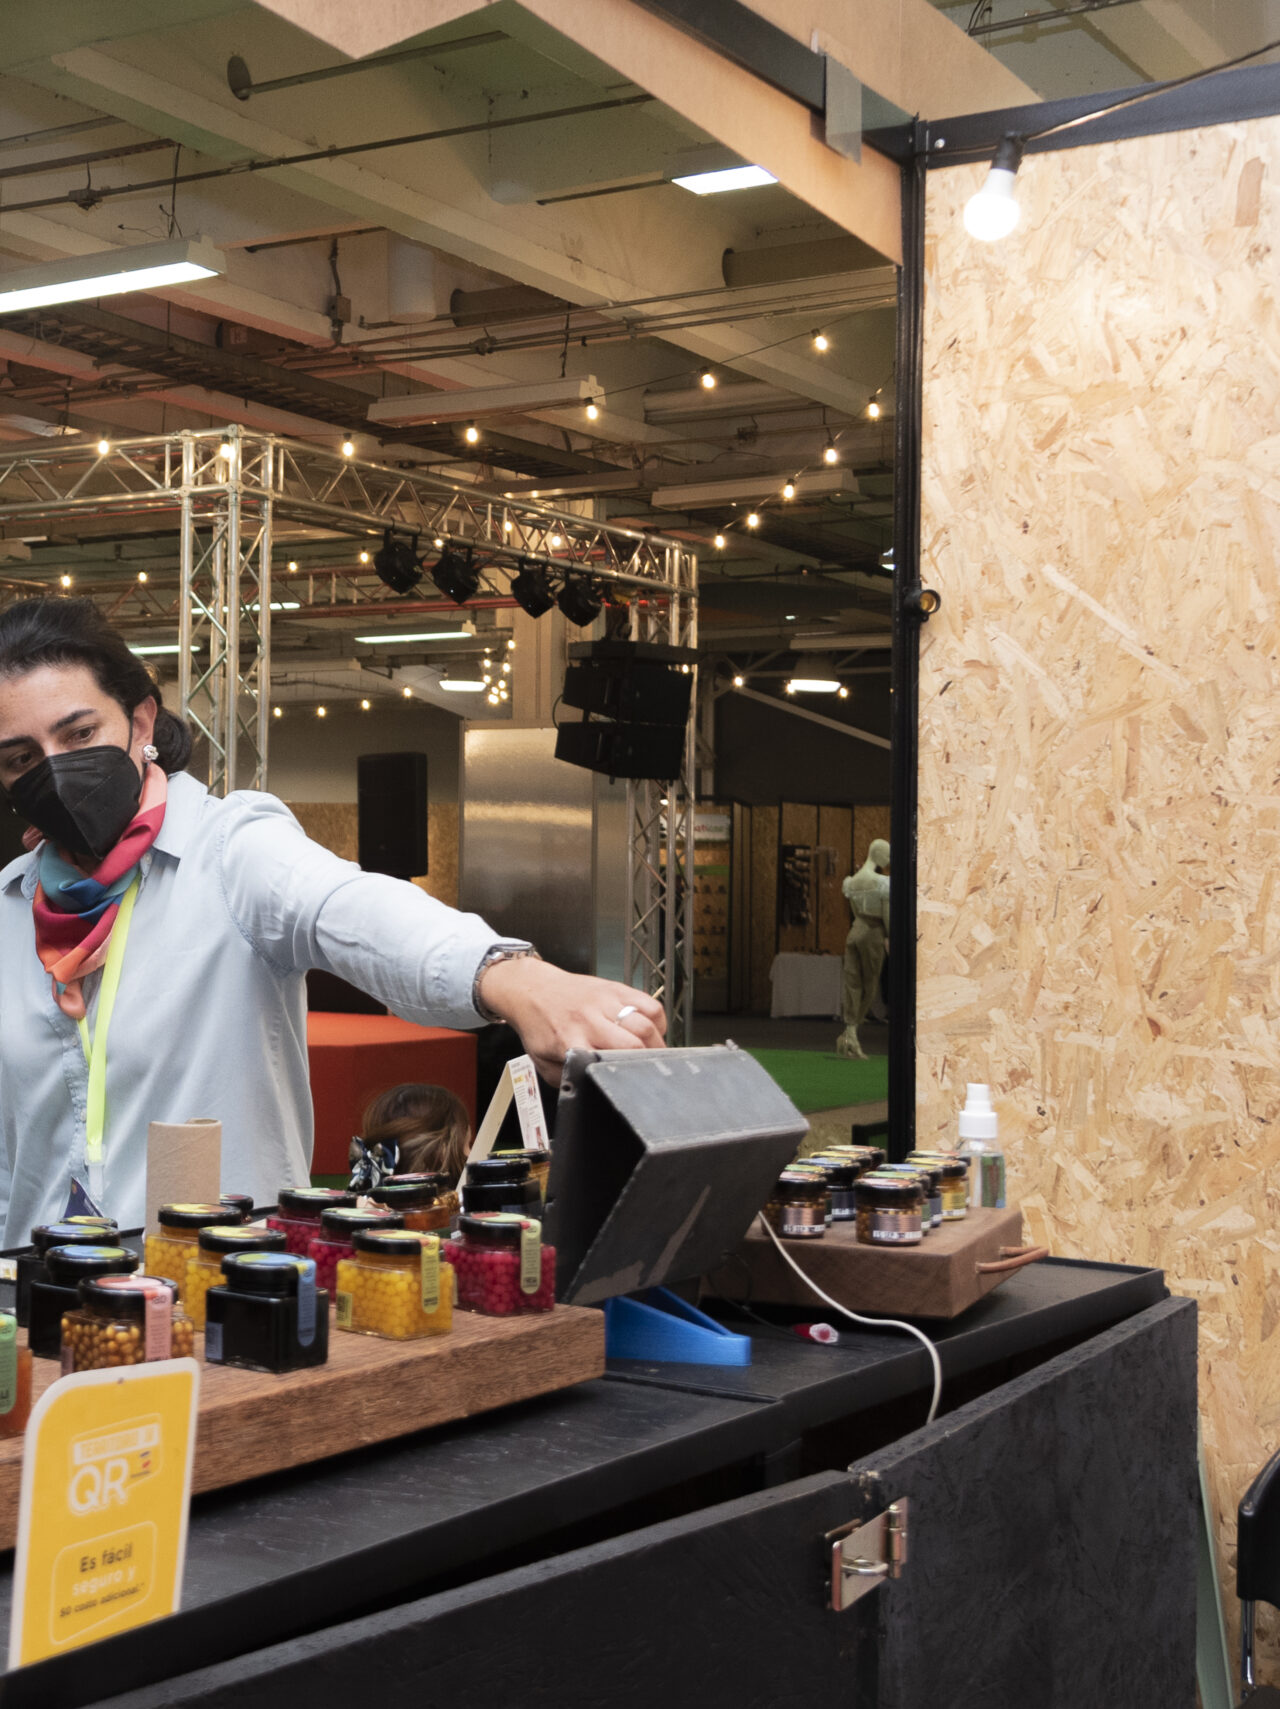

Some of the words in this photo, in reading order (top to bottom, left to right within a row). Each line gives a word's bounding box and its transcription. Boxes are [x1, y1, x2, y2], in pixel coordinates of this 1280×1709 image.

[69, 1457, 130, 1513] QR
[79, 1555, 97, 1573] Es
[102, 1541, 133, 1566] fácil
[72, 1569, 124, 1597] seguro
[126, 1564, 137, 1584] y
